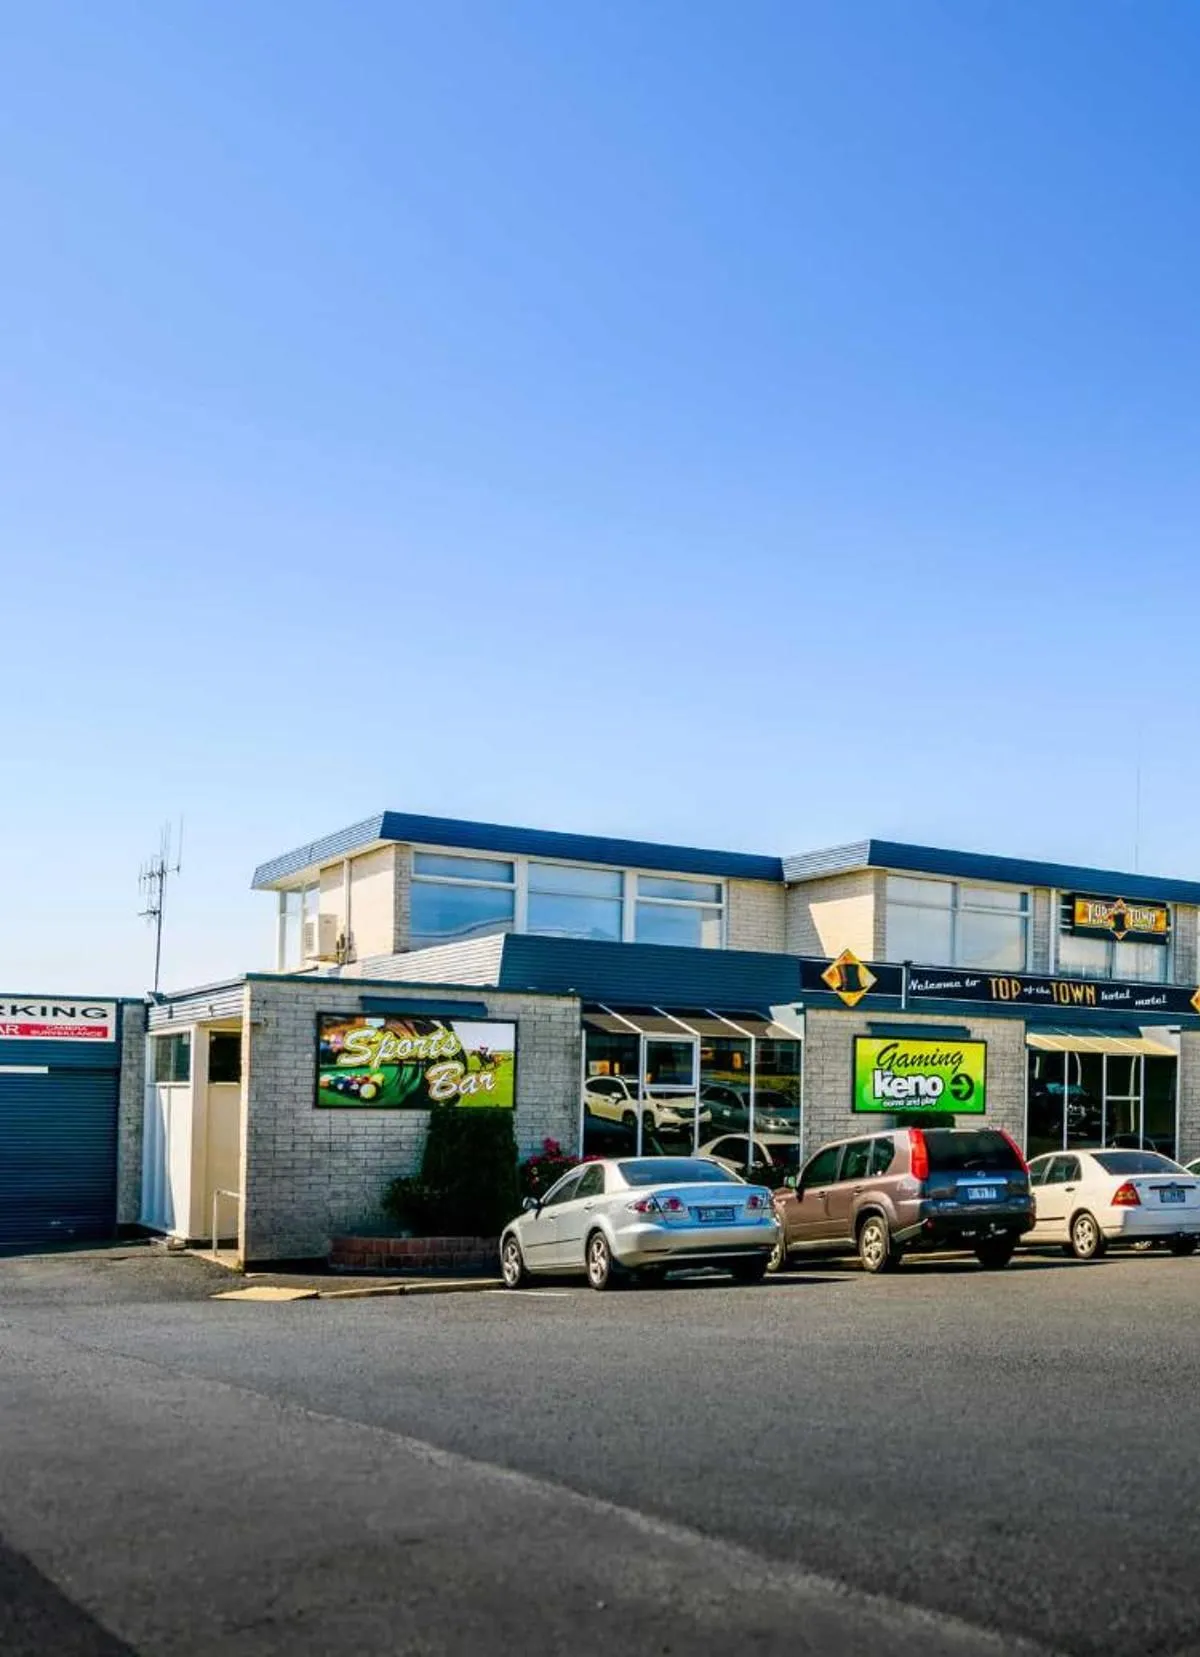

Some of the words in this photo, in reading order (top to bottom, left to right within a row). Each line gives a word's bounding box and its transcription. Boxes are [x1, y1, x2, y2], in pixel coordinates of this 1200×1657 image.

[909, 979, 962, 991] Welcome
[965, 978, 981, 988] to
[988, 977, 1021, 1000] TOP
[1050, 981, 1097, 1006] TOWN
[1101, 989, 1131, 1001] hotel
[1134, 994, 1169, 1006] motel
[0, 1004, 108, 1019] KING
[337, 1026, 463, 1070] Sports
[876, 1042, 964, 1075] Gaming
[424, 1060, 497, 1101] Bar
[874, 1068, 944, 1099] keno
